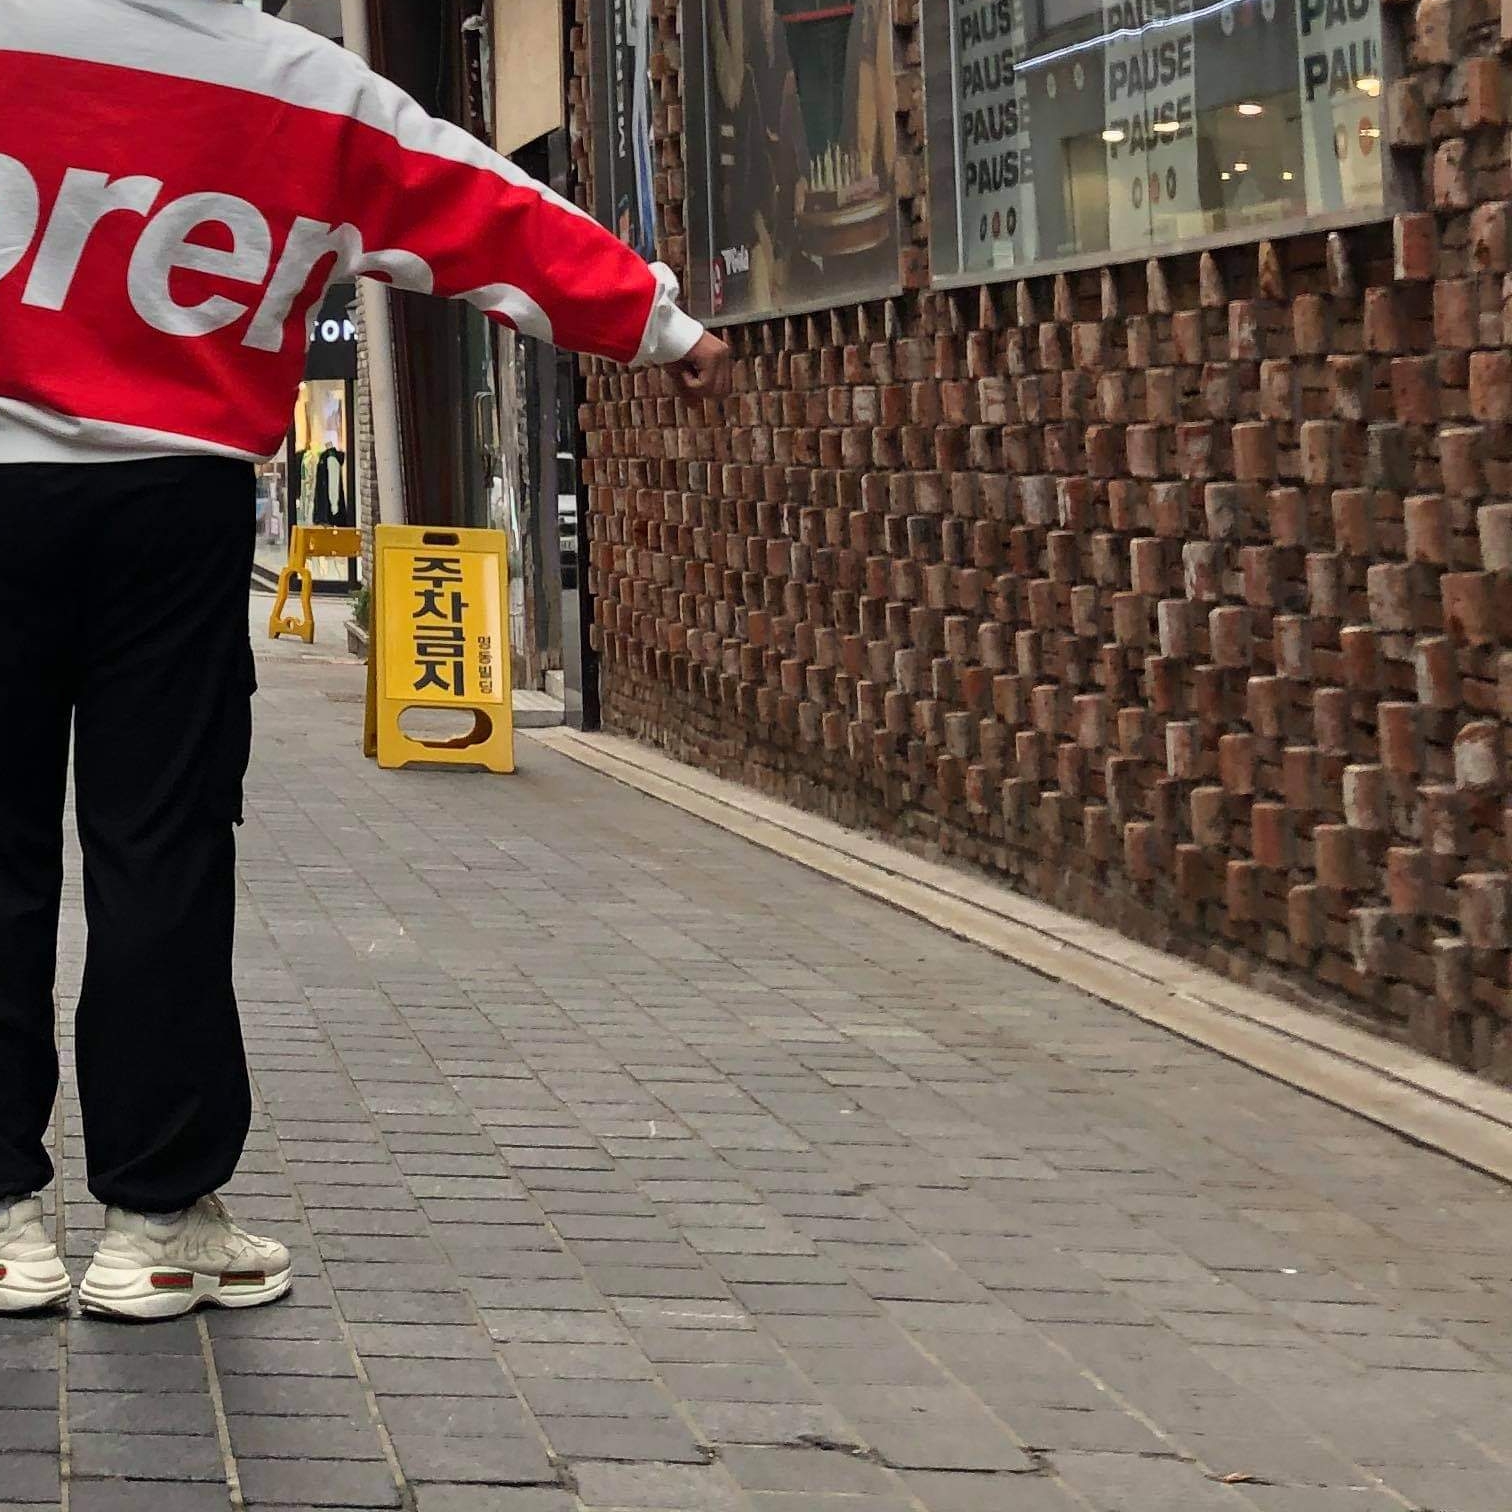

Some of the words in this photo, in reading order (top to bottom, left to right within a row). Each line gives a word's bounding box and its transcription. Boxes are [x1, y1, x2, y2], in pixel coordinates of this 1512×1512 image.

[1109, 34, 1192, 102] PAUSE
[1304, 40, 1376, 103] PAU
[1110, 95, 1193, 160] PAUSE
[412, 557, 469, 696] 주차금지
